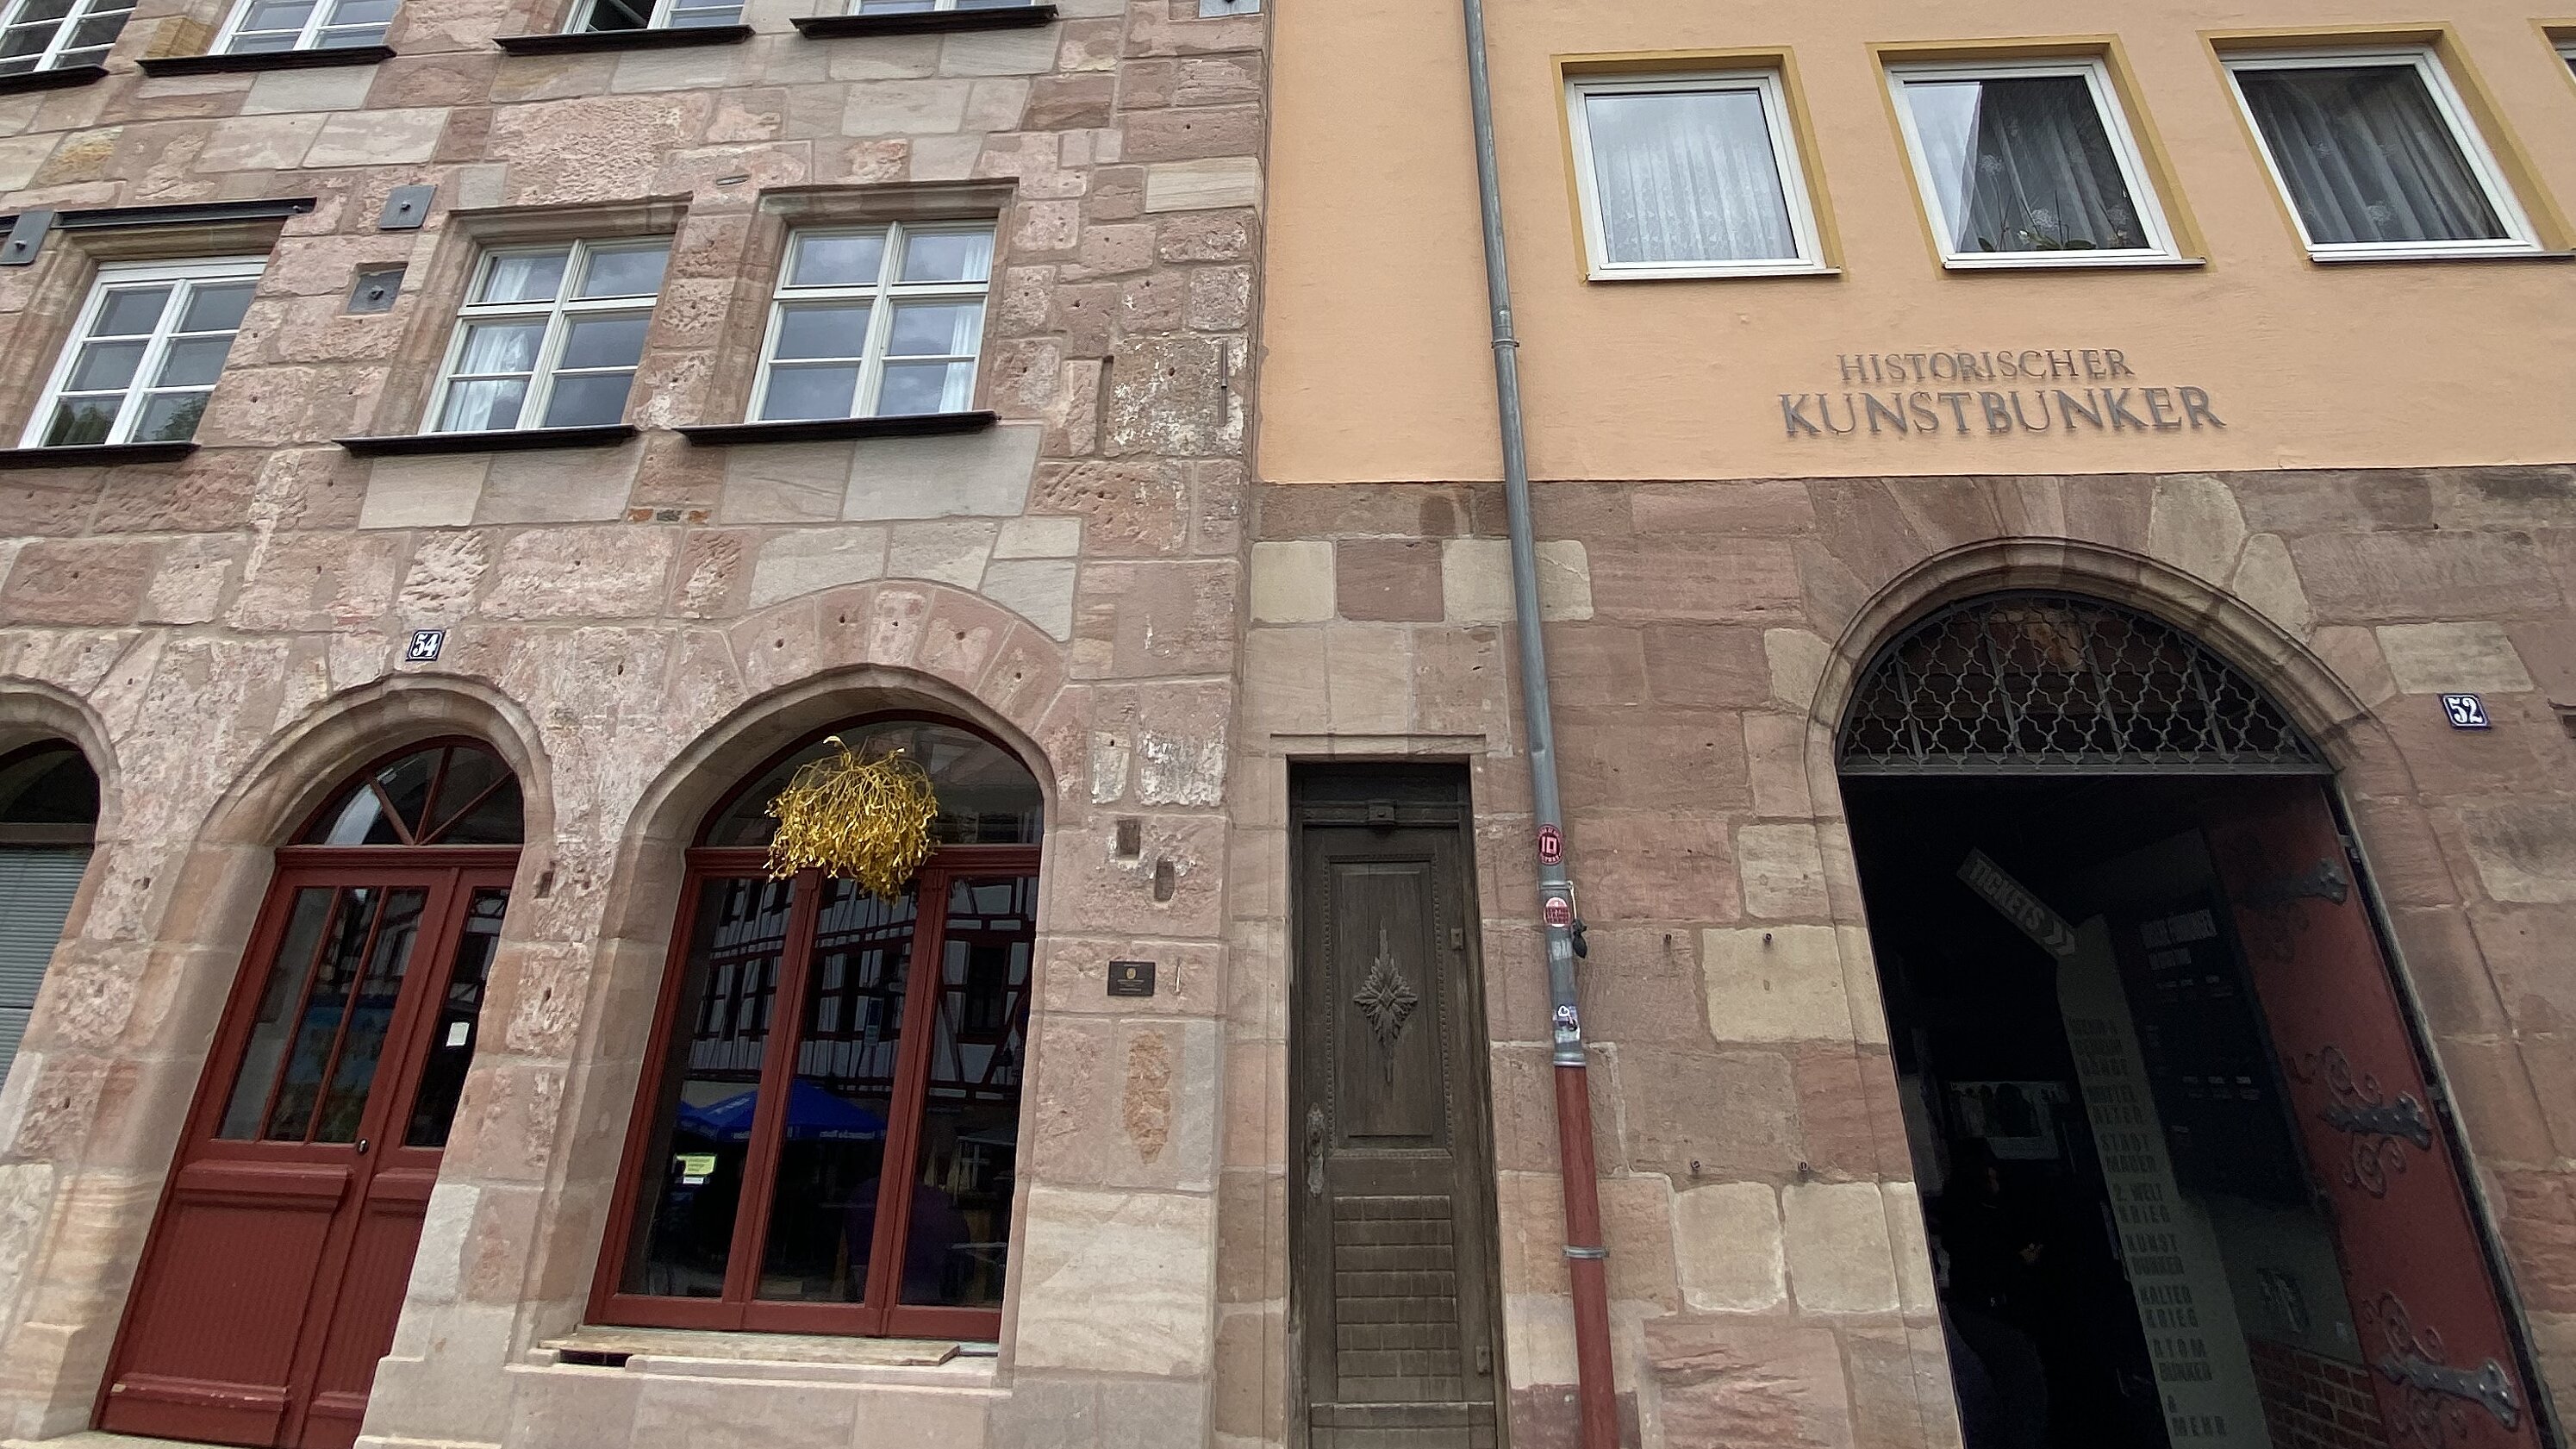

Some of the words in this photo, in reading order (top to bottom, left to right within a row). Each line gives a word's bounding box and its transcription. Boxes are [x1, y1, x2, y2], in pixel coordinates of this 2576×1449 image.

[1838, 348, 2134, 381] HISTORISCHER
[1778, 386, 2227, 433] KUNSTBUNKER
[412, 633, 440, 657] 54
[2448, 697, 2483, 723] 52
[1968, 857, 2045, 931] TICKETS
[2125, 1234, 2179, 1252] KUNST
[2138, 1285, 2193, 1305] KALTER
[2145, 1308, 2199, 1329] KRIEG
[2152, 1339, 2207, 1359] ATOM
[2171, 1415, 2228, 1438] MEHR
